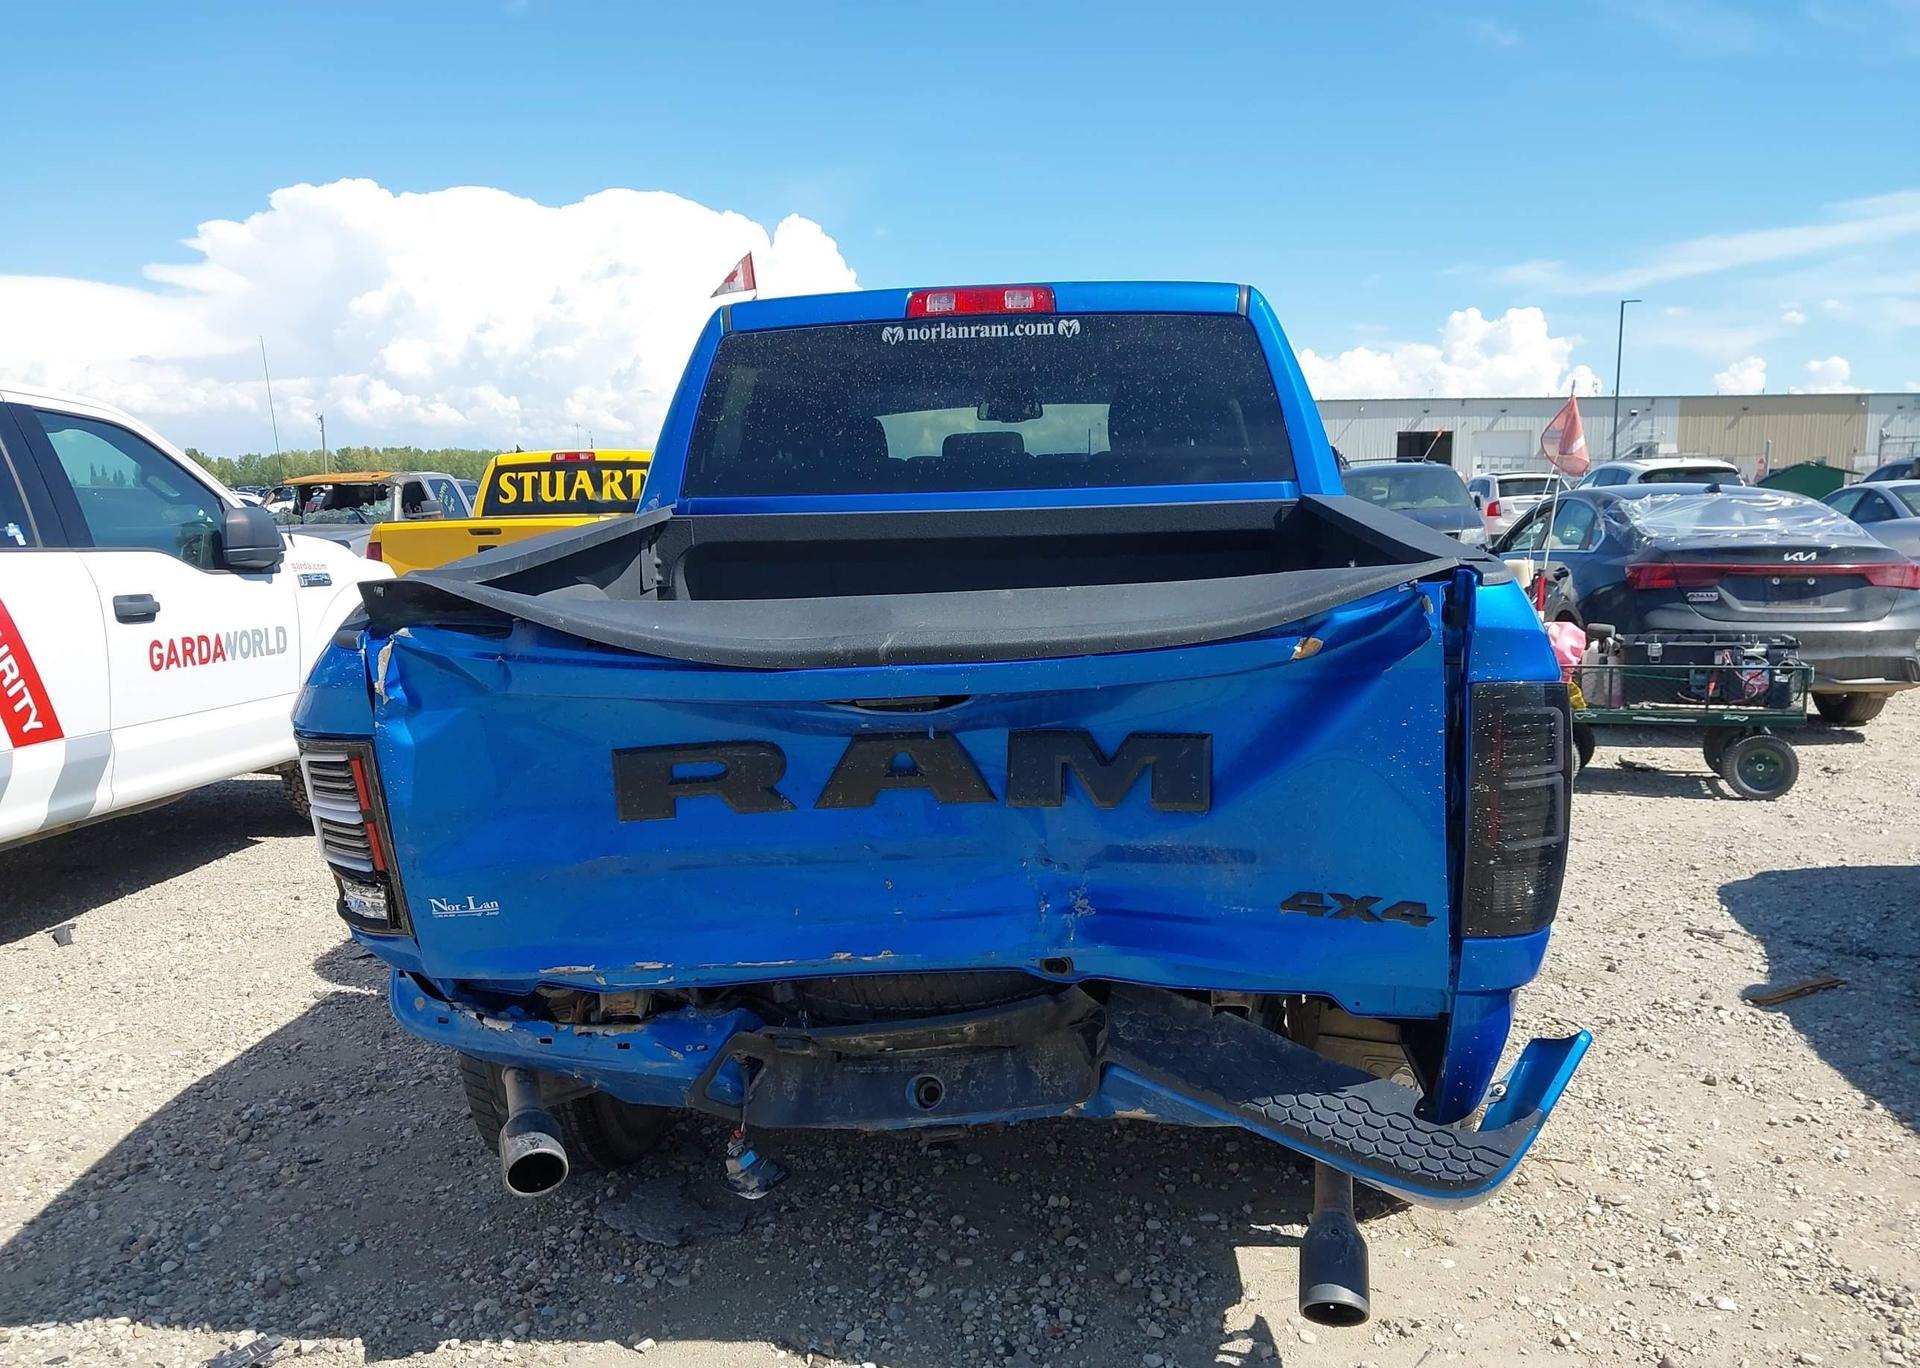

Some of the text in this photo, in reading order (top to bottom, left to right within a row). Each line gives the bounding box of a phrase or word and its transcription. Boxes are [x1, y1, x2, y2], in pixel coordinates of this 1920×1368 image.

[906, 321, 1055, 342] norlanram.com
[498, 469, 648, 504] STUART
[149, 626, 288, 672] GARDAWORLD
[611, 728, 1214, 823] RAM
[428, 895, 499, 912] Nor-Lan
